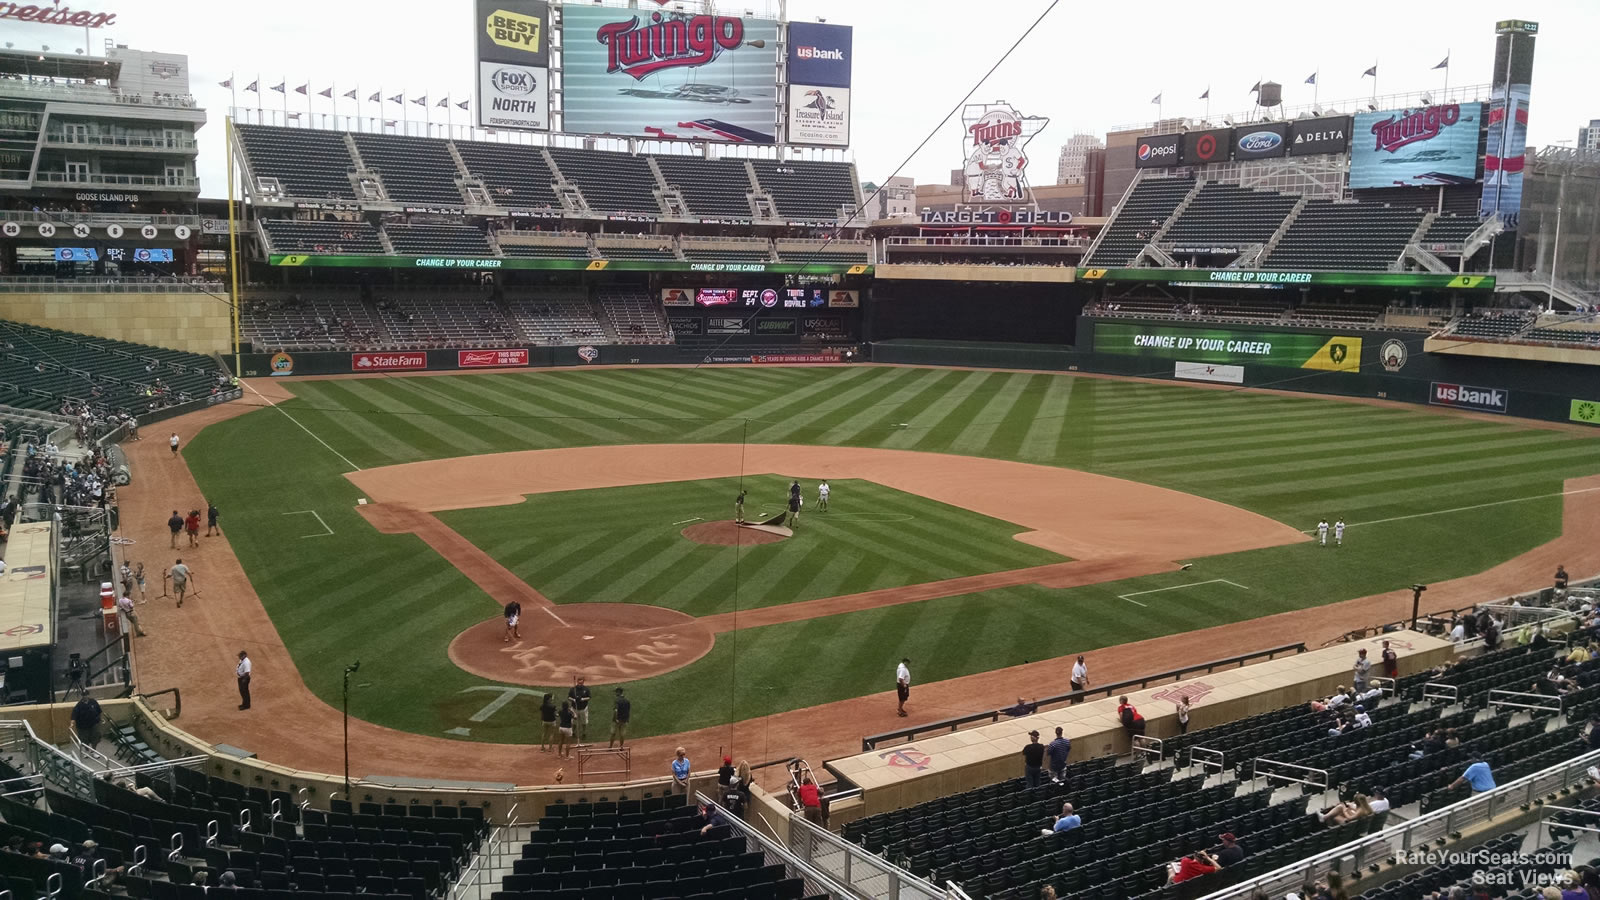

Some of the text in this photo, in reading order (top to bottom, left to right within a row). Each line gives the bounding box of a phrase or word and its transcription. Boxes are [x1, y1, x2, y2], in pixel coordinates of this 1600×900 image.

[493, 15, 539, 35] BEST
[494, 28, 534, 46] BUY
[597, 11, 744, 80] Twingo
[500, 71, 527, 86] FOX
[492, 97, 537, 113] NORTH
[0, 115, 38, 127] SEBALL
[795, 109, 844, 121] Treasure Island
[968, 119, 1022, 146] Twins
[1371, 104, 1460, 154] Twingo
[1246, 134, 1273, 149] Ford
[1306, 130, 1344, 142] DELTA
[1151, 144, 1177, 157] pepsi
[99, 193, 124, 202] ISLAND
[124, 194, 139, 202] PUB
[920, 211, 1073, 223] TARGET FIELD
[41, 226, 53, 234] 34
[180, 228, 186, 236] 3
[416, 259, 502, 268] CHANGE UP YOUR CAREER
[716, 263, 725, 271] UP
[742, 264, 766, 272] CAREER
[1210, 271, 1312, 283] CHANGE UP YOUR CAREER
[757, 320, 794, 330] SUBWAY
[1133, 335, 1272, 355] CHANGE UP YOUR CAREER
